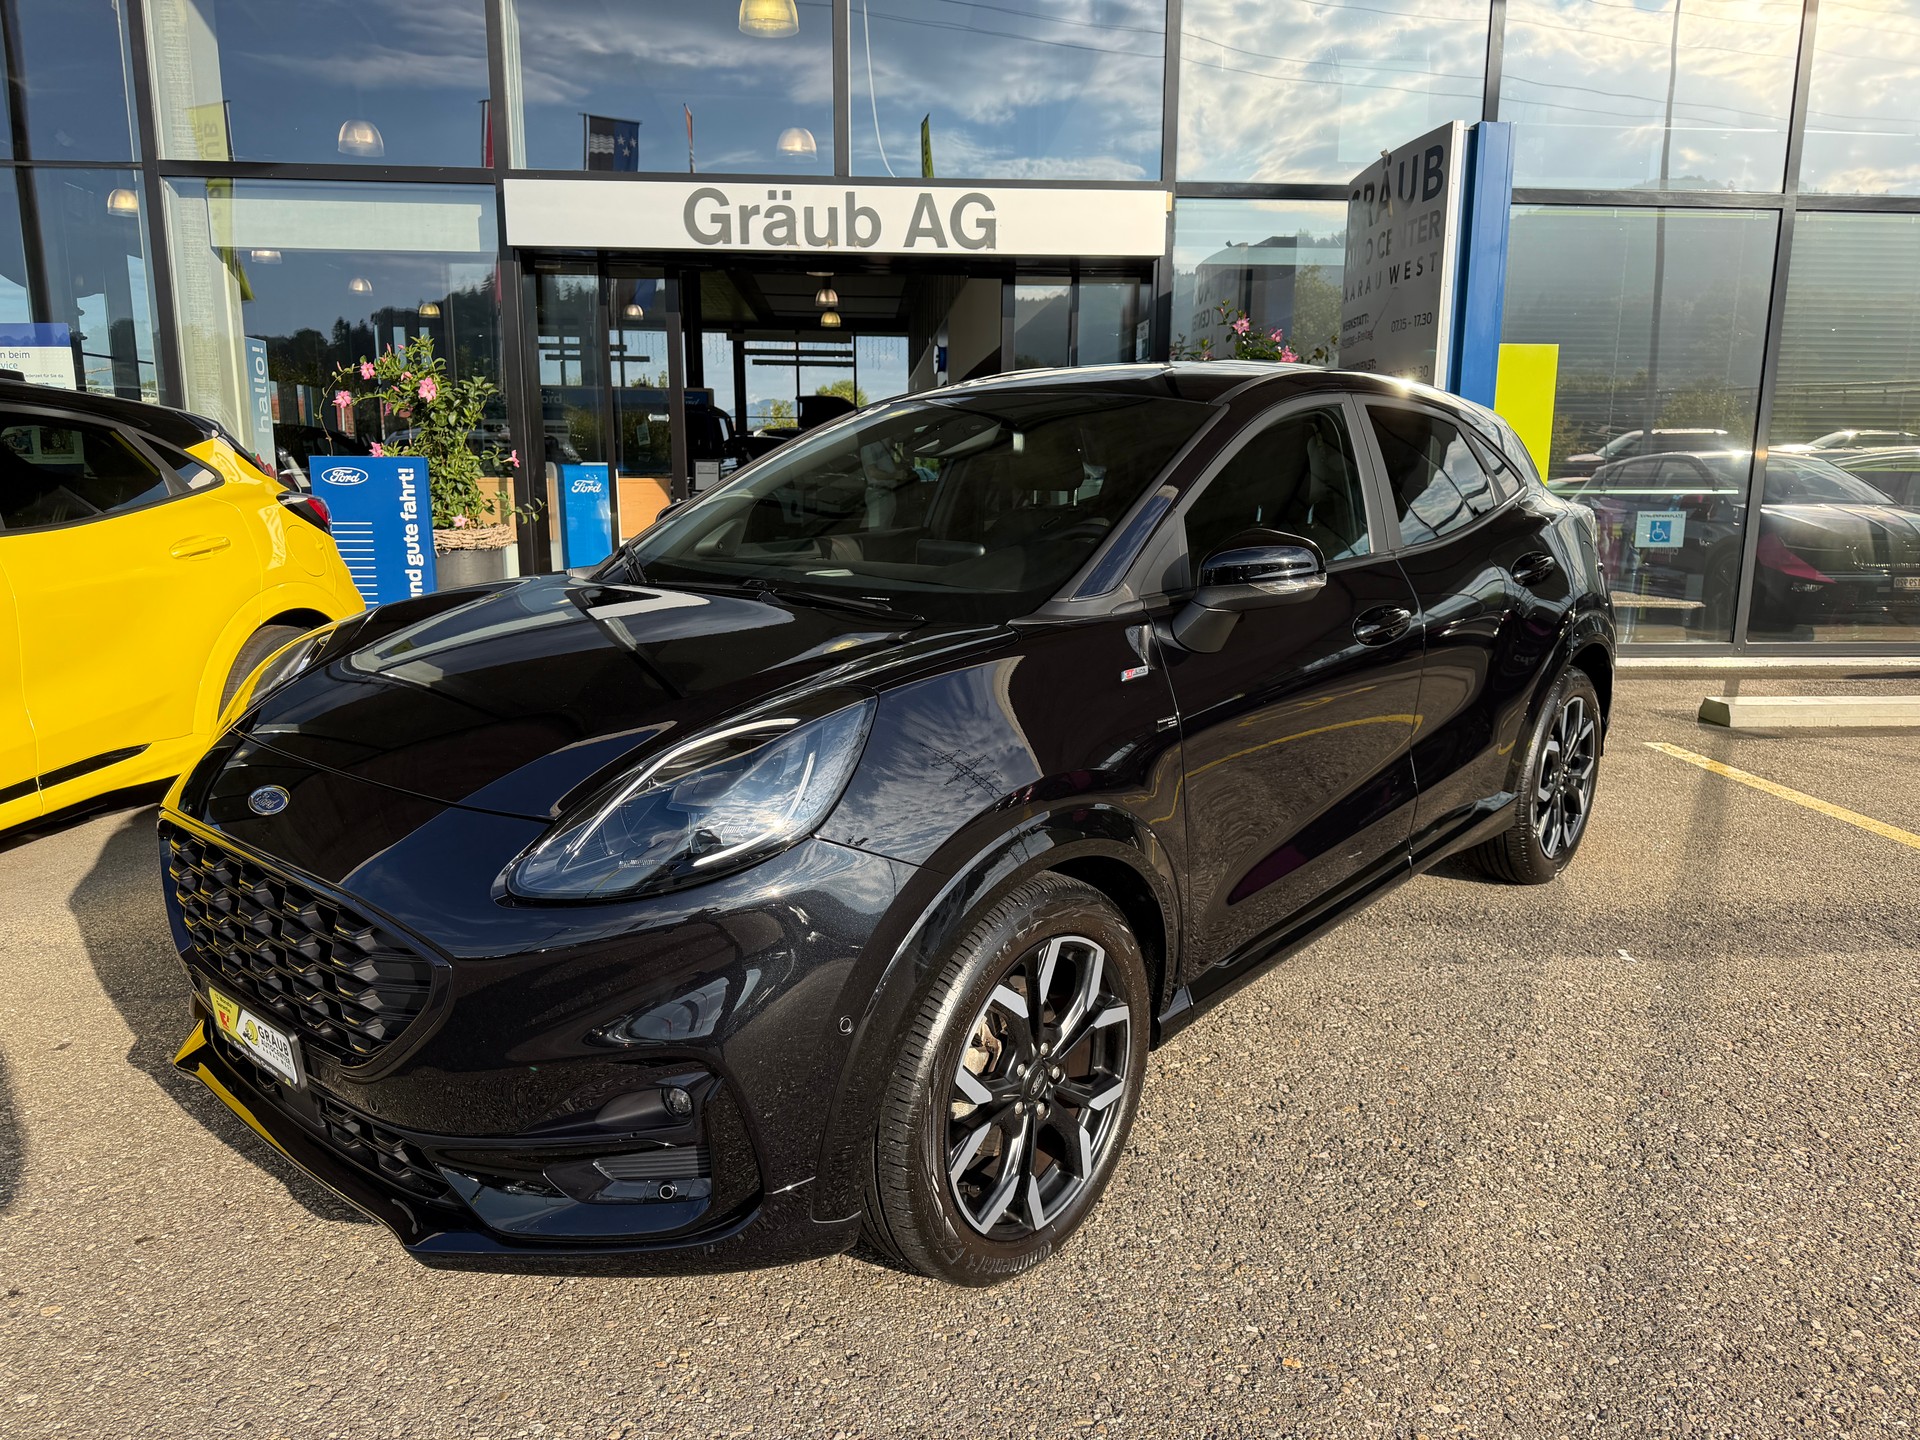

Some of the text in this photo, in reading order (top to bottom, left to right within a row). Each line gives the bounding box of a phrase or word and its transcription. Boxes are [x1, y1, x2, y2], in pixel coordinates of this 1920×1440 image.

[683, 186, 997, 251] Gräub AG
[1343, 252, 1438, 304] AARAU WEST
[1414, 312, 1432, 327] 17.30
[8, 350, 30, 359] beim
[252, 346, 270, 433] hallo!
[541, 392, 564, 404] ord
[329, 468, 360, 483] Ford
[571, 479, 602, 494] Ford
[397, 468, 418, 521] fahrt!
[403, 523, 425, 567] gute
[257, 1025, 289, 1057] GRÄUB
